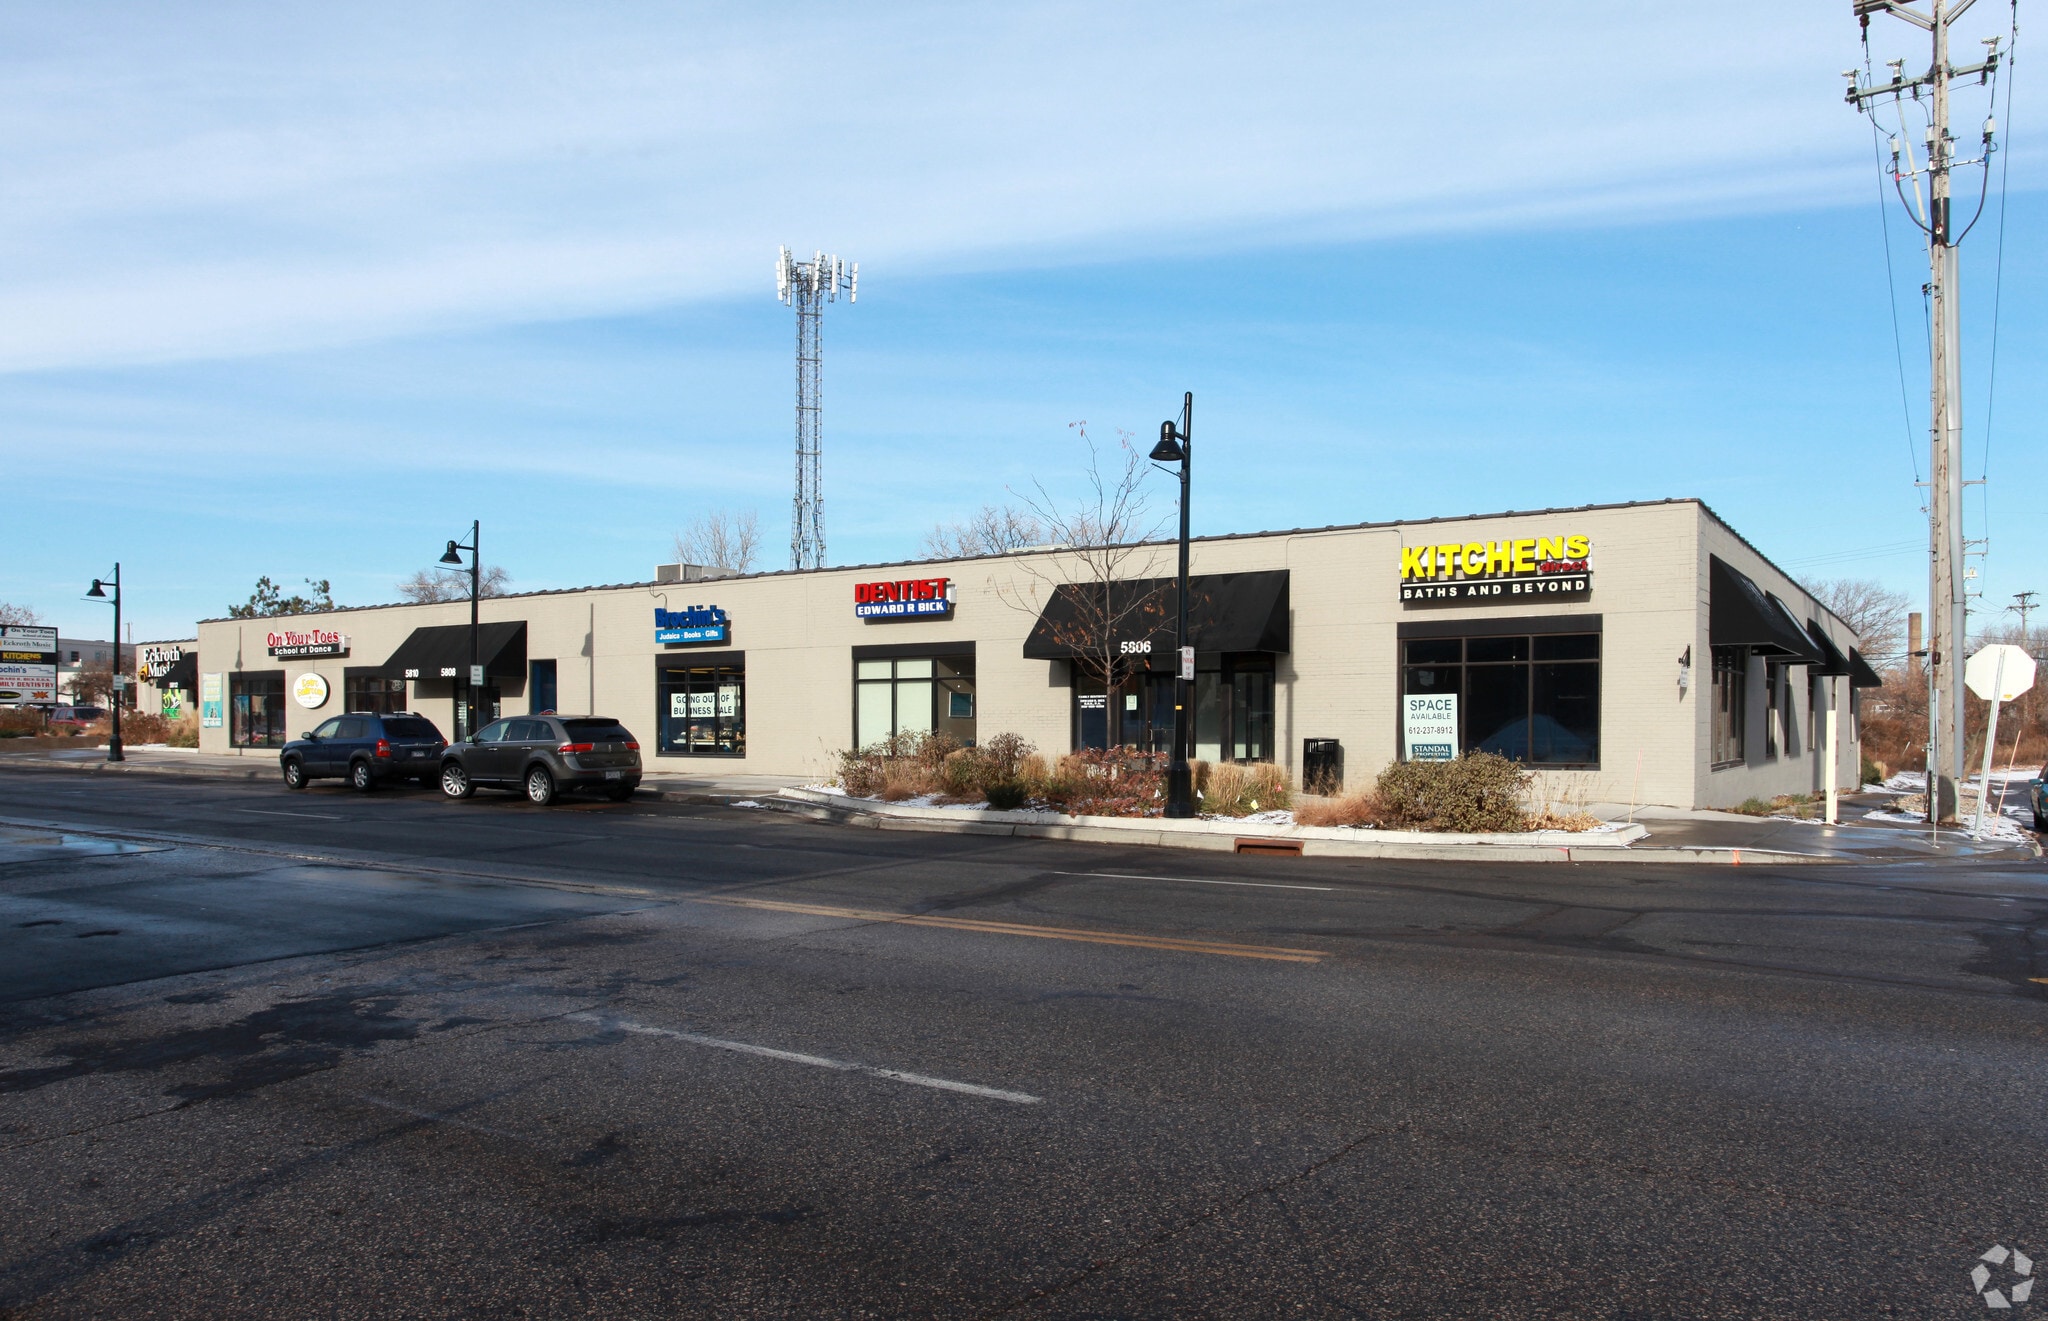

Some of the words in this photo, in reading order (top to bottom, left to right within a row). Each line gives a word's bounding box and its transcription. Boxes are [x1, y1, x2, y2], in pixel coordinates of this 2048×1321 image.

[1401, 534, 1590, 579] KITCHENS
[1540, 560, 1588, 574] direct
[855, 578, 951, 603] DENTIST
[1404, 587, 1458, 599] BATHS
[1467, 585, 1502, 596] AND
[1512, 580, 1585, 594] BEYOND
[857, 604, 904, 616] EDWARD
[907, 603, 915, 613] R
[918, 601, 945, 612] BICK
[654, 605, 726, 628] Brochin's
[267, 632, 283, 647] On
[284, 631, 311, 646] Your
[312, 629, 339, 644] Toes
[659, 631, 680, 640] Judaica
[683, 630, 701, 639] Books
[705, 629, 718, 638] Gifts
[274, 647, 298, 655] School
[300, 646, 307, 654] of
[1120, 640, 1152, 654] 5806
[3, 652, 42, 660] KITCHENS
[143, 646, 180, 663] Eckroth
[148, 661, 175, 677] Musi
[405, 669, 419, 678] 5810
[440, 668, 456, 677] 5808
[676, 696, 701, 704] GONG
[720, 694, 730, 703] OF
[1410, 699, 1452, 711] SPACE
[674, 706, 712, 715] BUINESS
[716, 705, 732, 714] ALE
[1408, 726, 1453, 735] 612-237-8912
[1414, 745, 1450, 753] STANDAL
